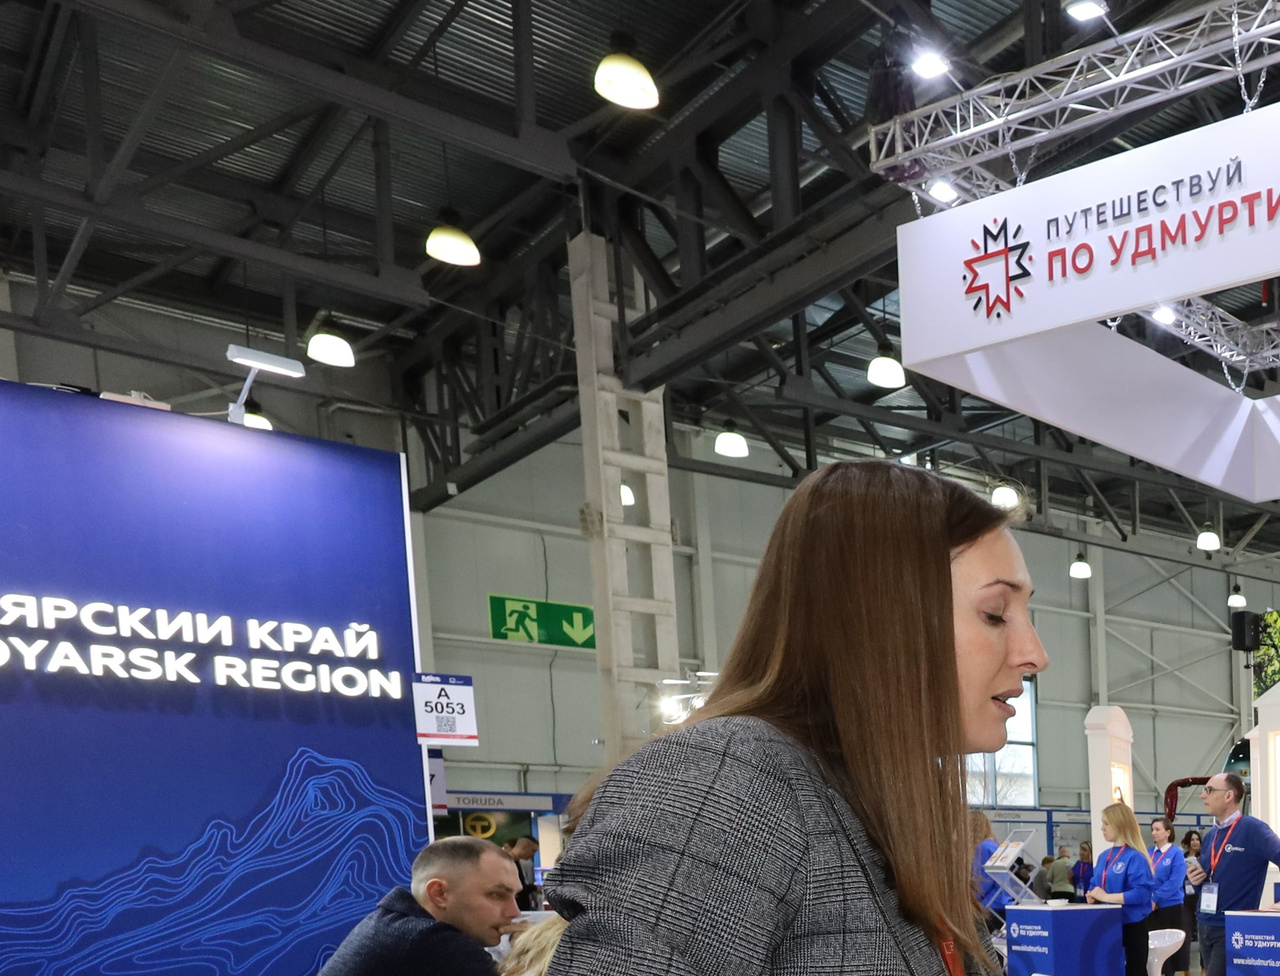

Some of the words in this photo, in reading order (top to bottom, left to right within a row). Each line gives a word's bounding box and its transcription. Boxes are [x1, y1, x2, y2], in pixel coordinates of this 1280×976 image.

[1046, 156, 1243, 240] ПУТЕШЕСТВУЙ
[1047, 242, 1095, 281] ПО
[246, 618, 379, 660] КРАЙ
[213, 655, 402, 700] REGION
[437, 687, 451, 700] A
[424, 700, 466, 716] 5053
[455, 796, 504, 806] TORUDA
